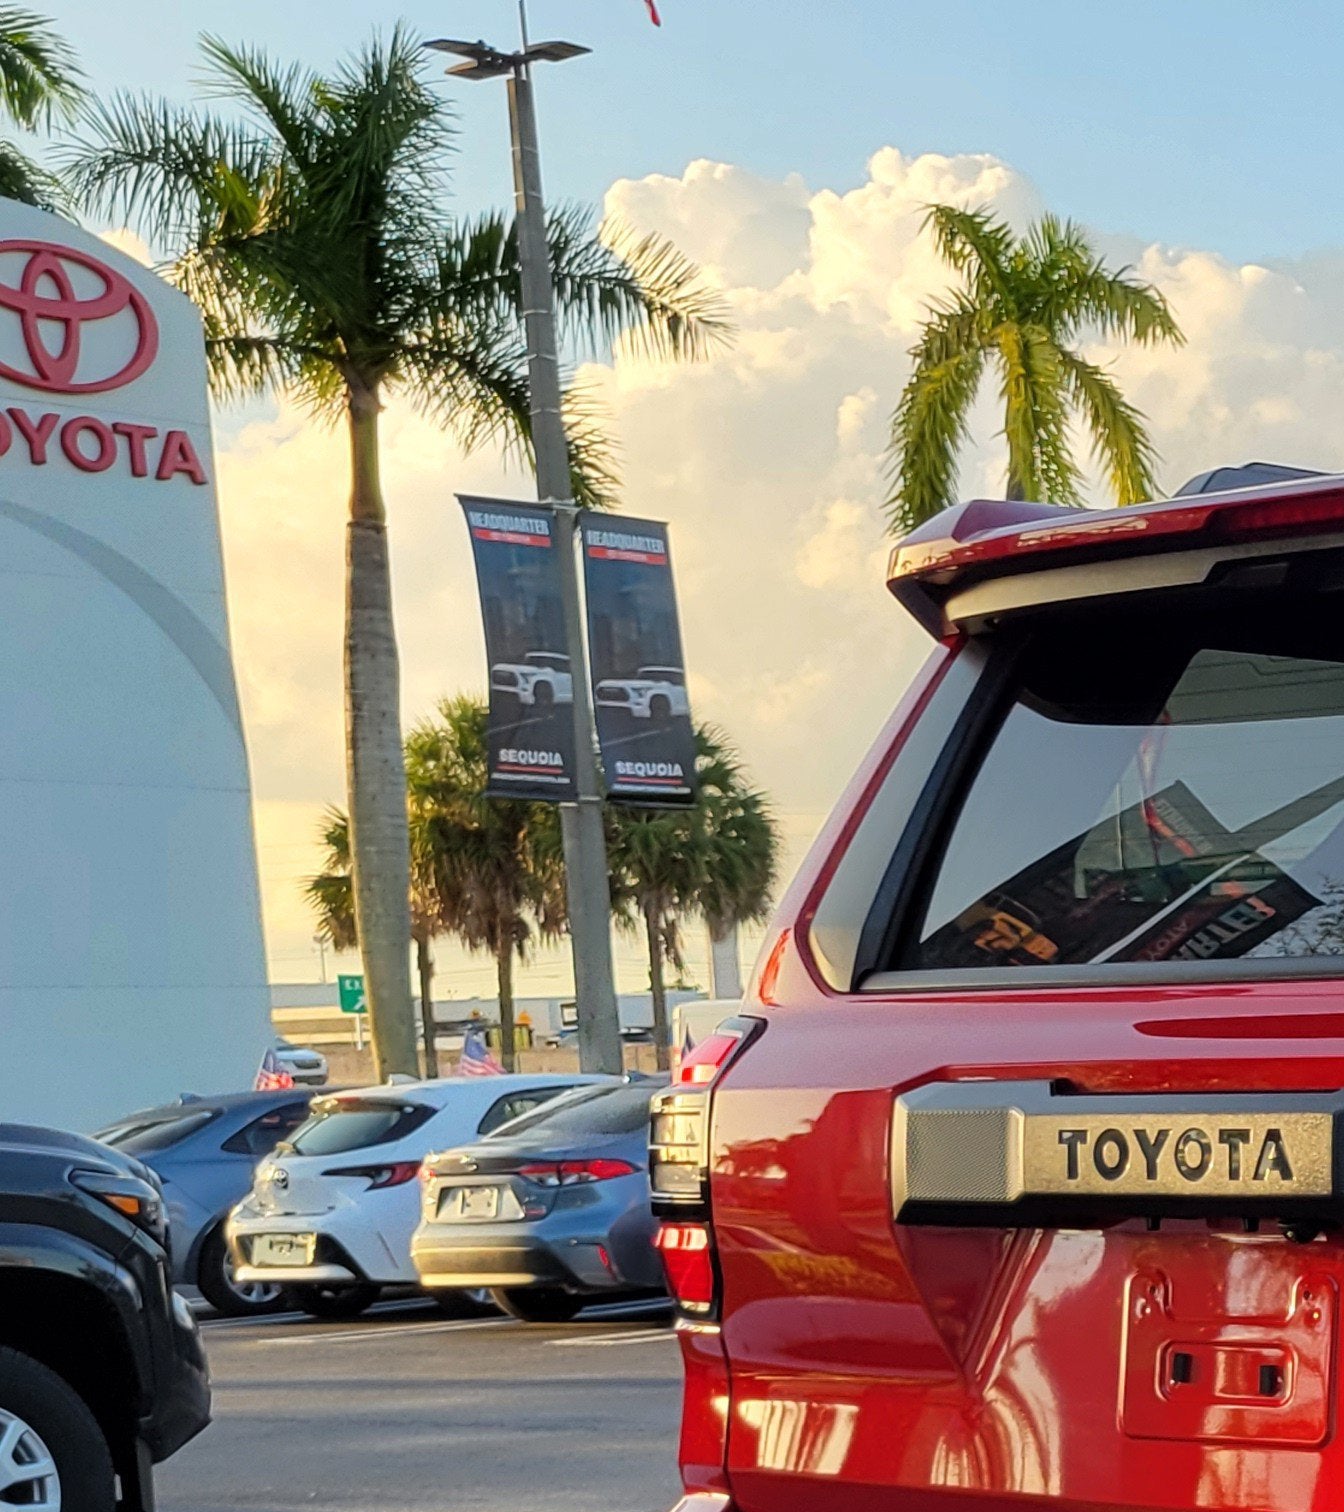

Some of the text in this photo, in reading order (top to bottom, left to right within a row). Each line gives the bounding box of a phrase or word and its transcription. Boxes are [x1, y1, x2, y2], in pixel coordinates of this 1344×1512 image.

[499, 749, 563, 766] SEQUOIA
[615, 761, 683, 776] SEQUOIA
[1058, 1128, 1293, 1182] TOYOTA
